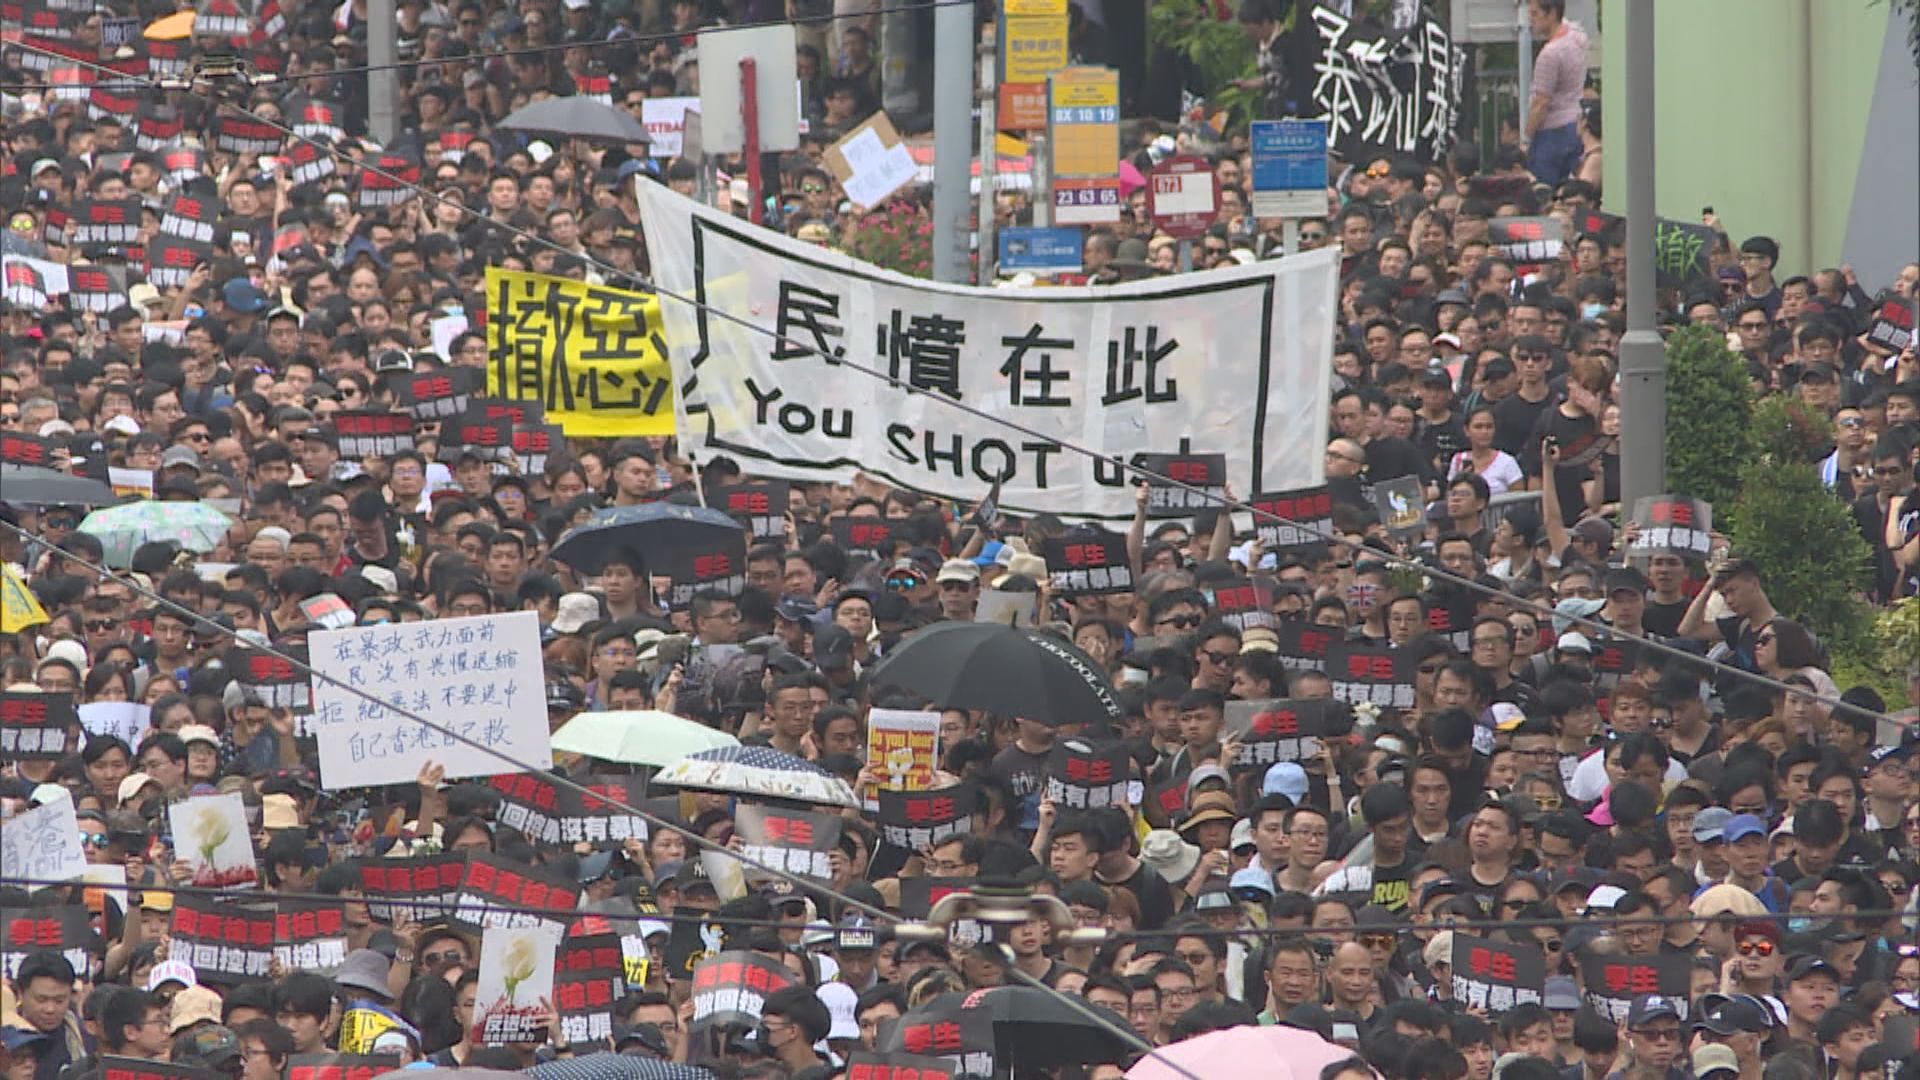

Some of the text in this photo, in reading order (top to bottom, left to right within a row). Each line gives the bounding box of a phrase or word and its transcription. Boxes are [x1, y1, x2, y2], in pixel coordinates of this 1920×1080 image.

[1079, 109, 1093, 122] 10
[1100, 108, 1114, 121] 19
[1058, 189, 1116, 205] 23 63 65
[770, 280, 1180, 407] 民憤在此
[745, 377, 853, 439] You
[886, 422, 1062, 489] SHOT
